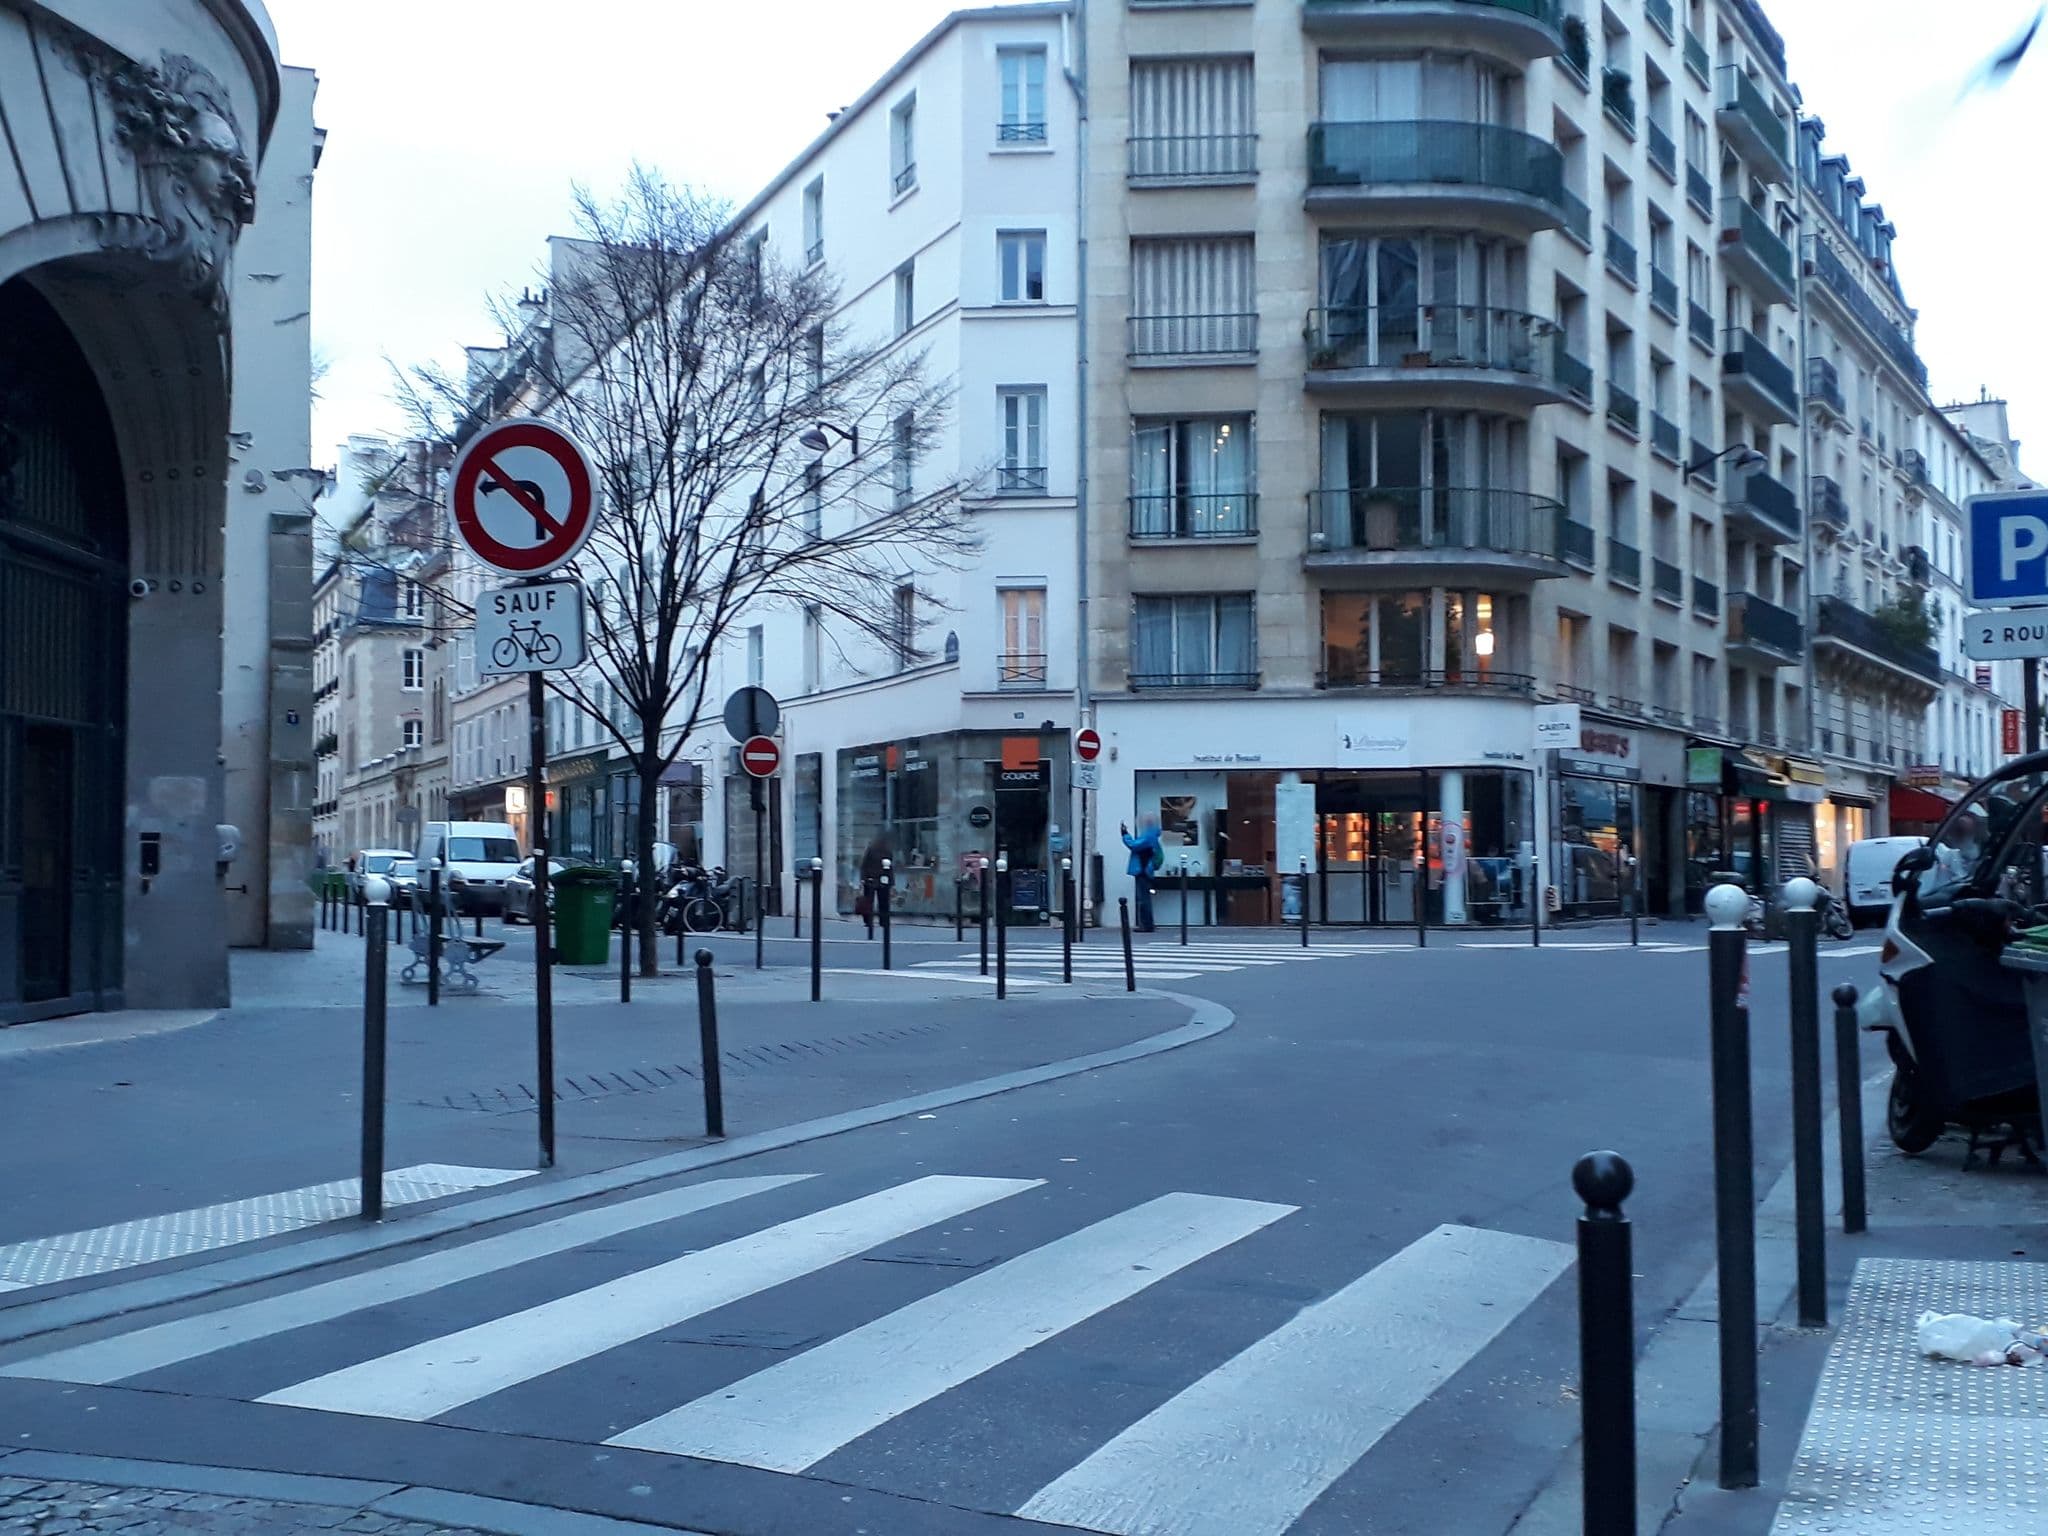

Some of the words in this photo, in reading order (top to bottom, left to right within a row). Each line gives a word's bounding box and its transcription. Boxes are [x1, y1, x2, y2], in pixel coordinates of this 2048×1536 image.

[2000, 515, 2048, 581] P
[494, 591, 557, 615] SAUF
[1982, 629, 1994, 644] 2
[2004, 625, 2048, 642] ROU
[1538, 723, 1571, 732] CARITA
[1001, 772, 1041, 780] GOUACHE
